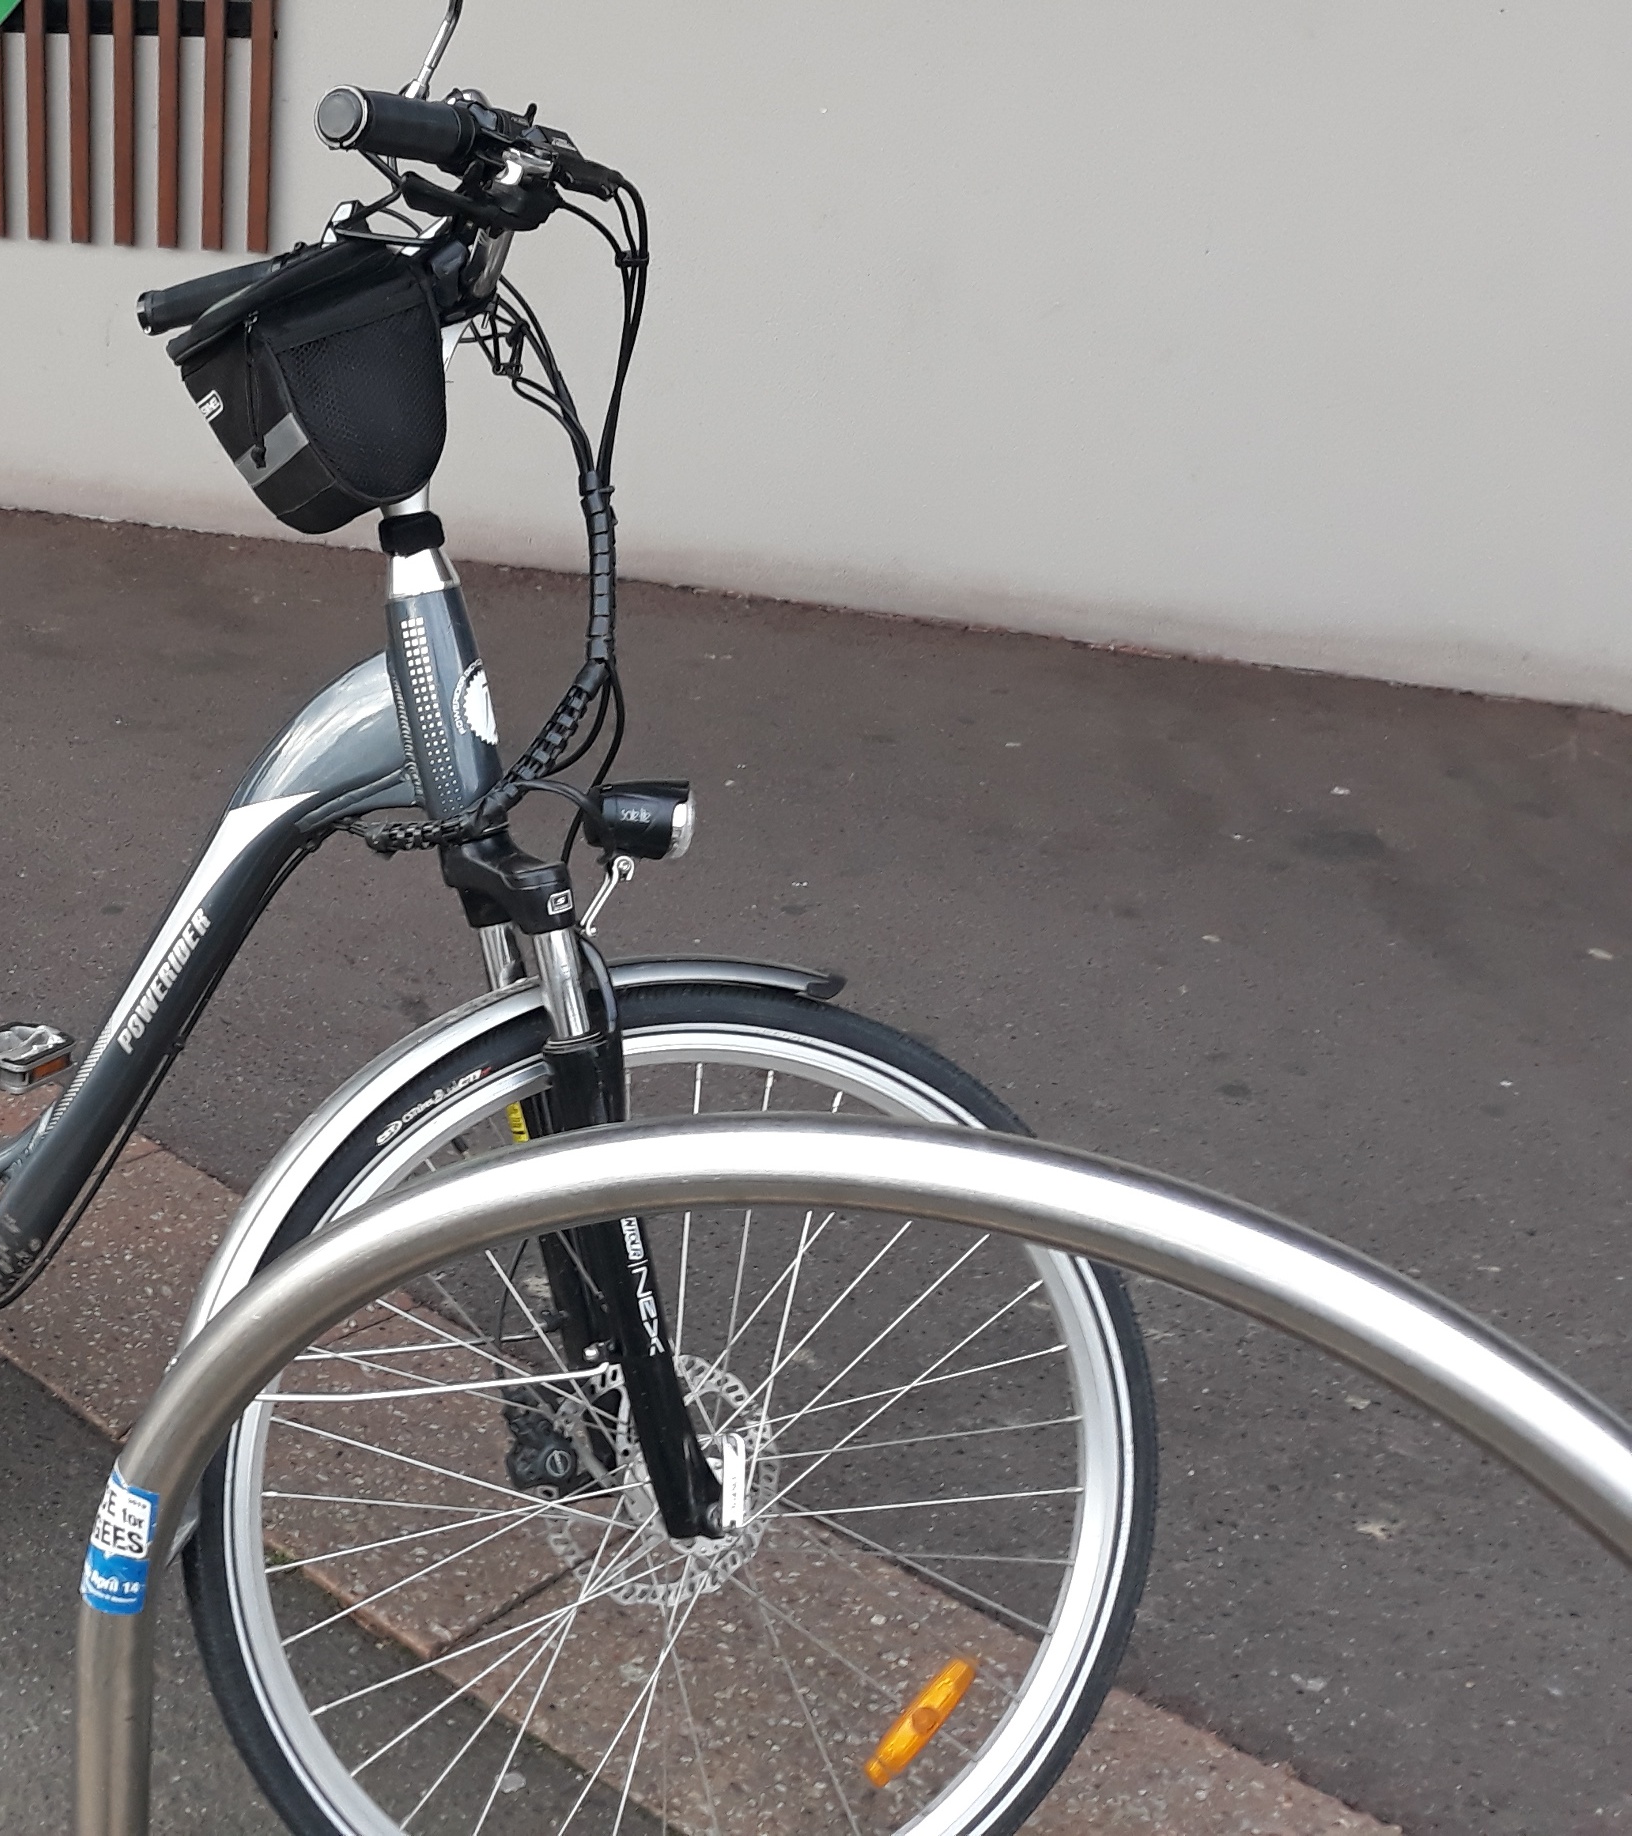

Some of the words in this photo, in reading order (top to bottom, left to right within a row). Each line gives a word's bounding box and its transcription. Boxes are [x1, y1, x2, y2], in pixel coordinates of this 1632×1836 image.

[118, 907, 212, 1055] POWERIDER
[620, 1216, 645, 1260] NTOUR
[631, 1266, 666, 1357] NEX
[122, 1508, 145, 1529] for
